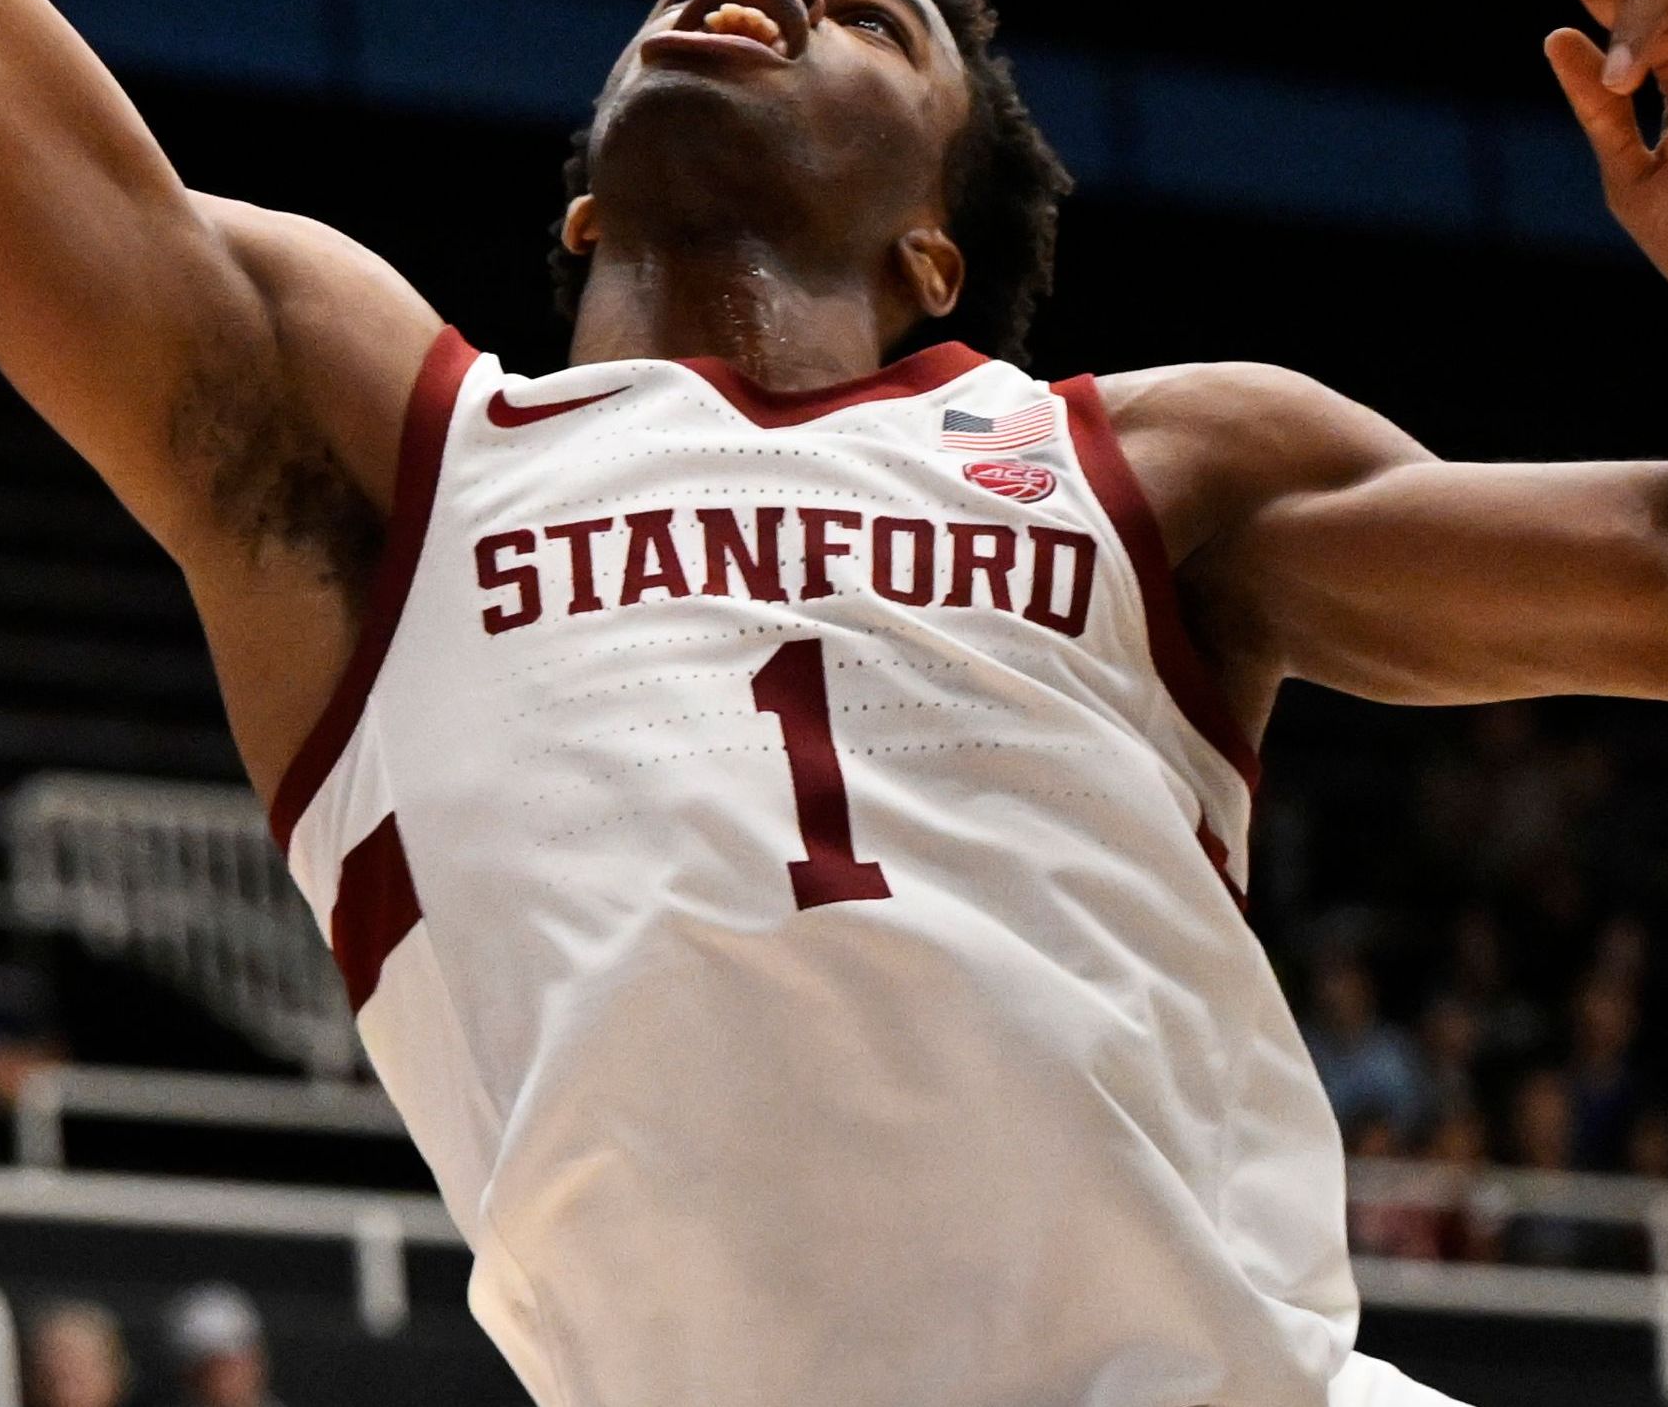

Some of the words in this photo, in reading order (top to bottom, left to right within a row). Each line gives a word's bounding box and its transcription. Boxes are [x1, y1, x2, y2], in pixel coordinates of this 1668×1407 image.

[976, 467, 1046, 484] ACC
[474, 507, 1098, 638] STANFORD
[750, 638, 894, 912] 1
